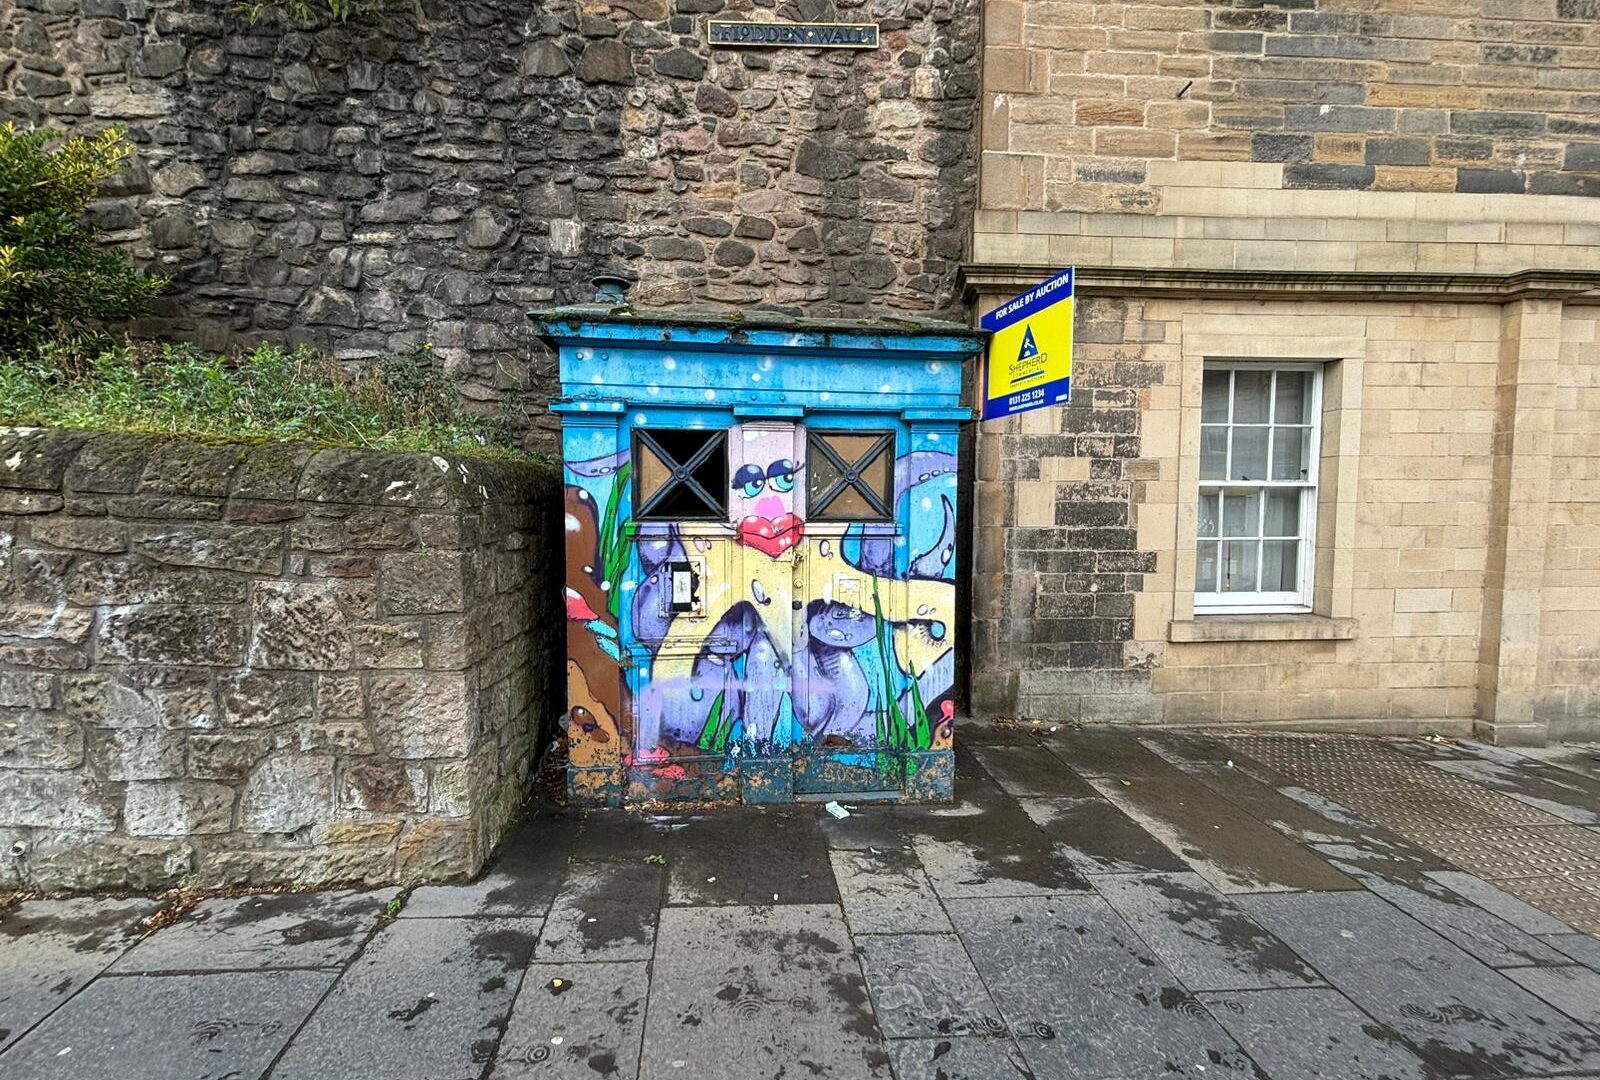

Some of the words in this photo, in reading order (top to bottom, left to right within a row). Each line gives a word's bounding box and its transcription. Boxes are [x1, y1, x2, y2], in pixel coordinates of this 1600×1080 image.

[813, 27, 869, 44] WALL
[995, 307, 1008, 320] FOR
[1008, 298, 1024, 313] SALE
[1025, 292, 1035, 305] BY
[1035, 273, 1069, 299] AUCTION
[1009, 352, 1047, 375] SHEPHERD
[1009, 394, 1020, 405] 0131
[1021, 392, 1031, 402] 225
[1032, 388, 1045, 399] 1234
